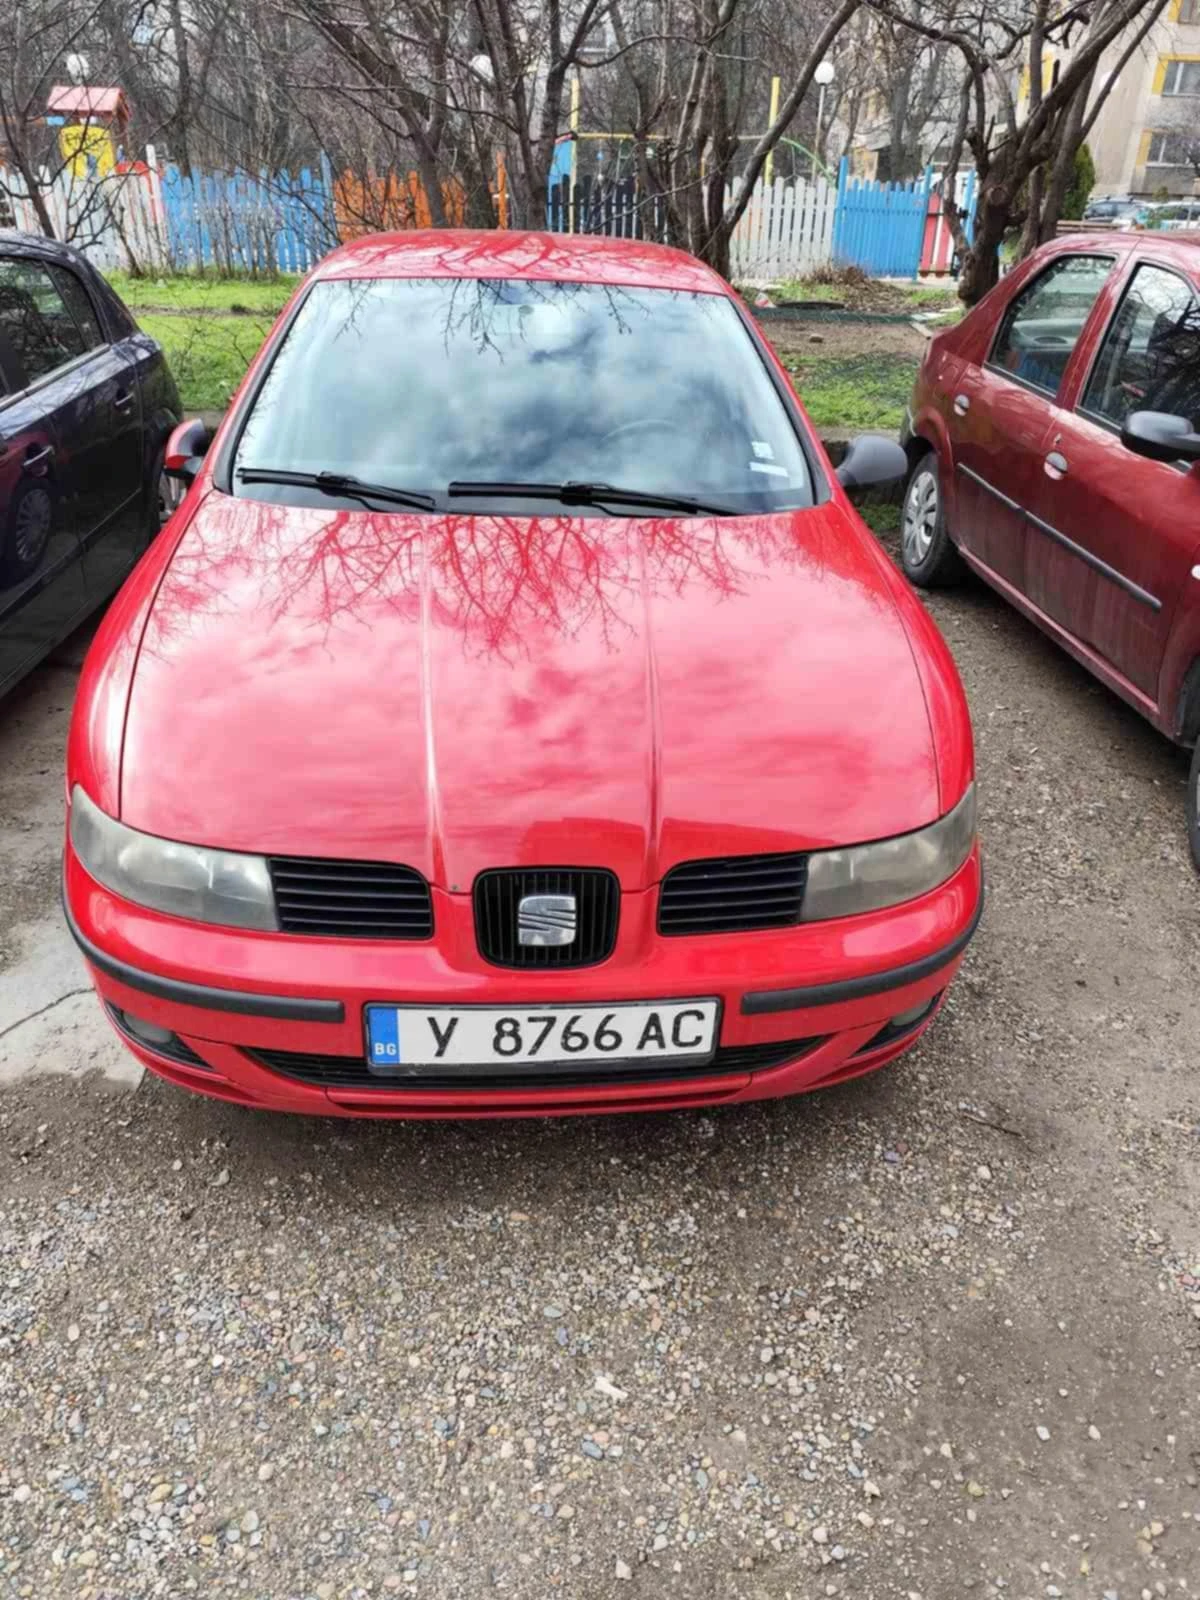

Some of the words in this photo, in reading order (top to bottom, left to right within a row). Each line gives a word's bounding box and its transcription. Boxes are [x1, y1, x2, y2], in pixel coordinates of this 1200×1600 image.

[492, 1014, 622, 1057] 8766
[636, 1009, 705, 1050] AC
[374, 1042, 397, 1056] BG
